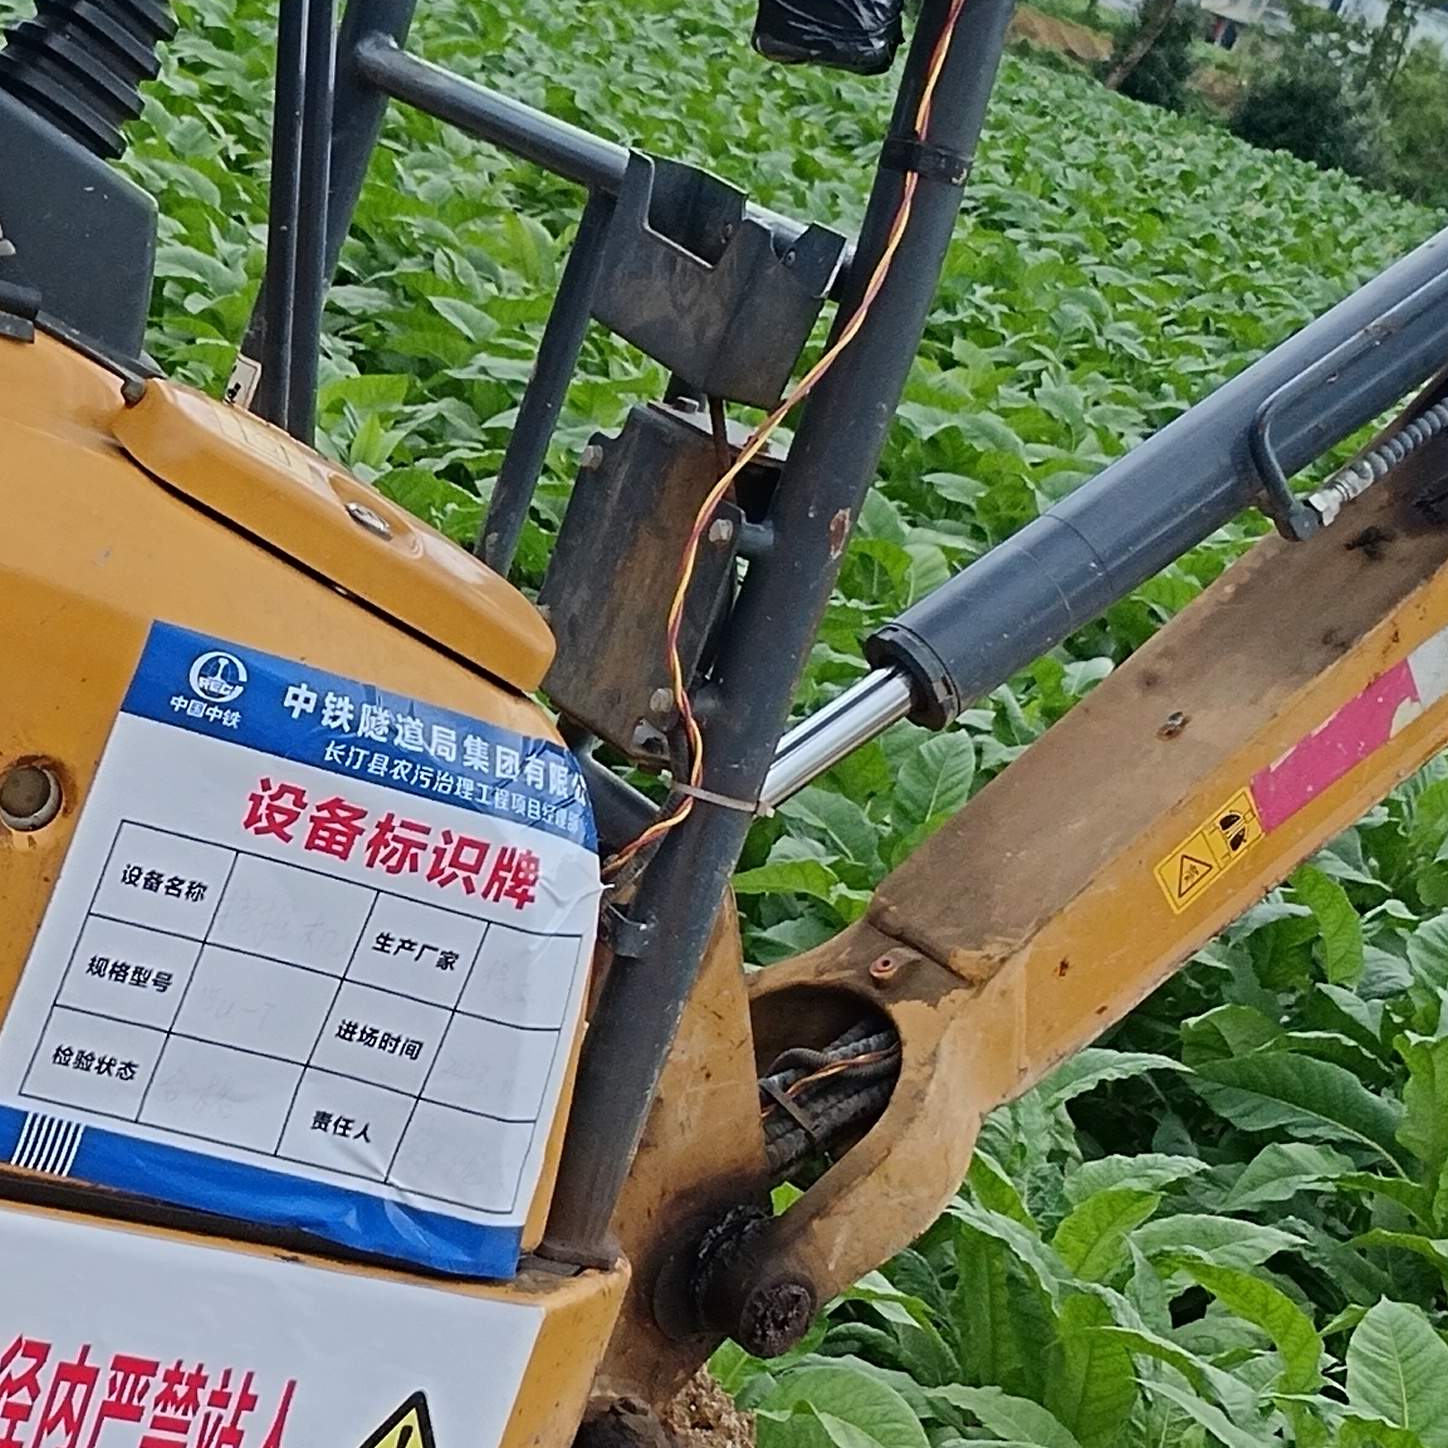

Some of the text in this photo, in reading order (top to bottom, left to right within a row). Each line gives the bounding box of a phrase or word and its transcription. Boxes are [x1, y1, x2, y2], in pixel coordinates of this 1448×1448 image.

[169, 694, 242, 729] 中国中铁
[242, 777, 542, 910] 设备标识牌
[120, 863, 208, 902] 设备名称
[371, 931, 460, 971] 生产厂家
[85, 955, 173, 993] 规格型号
[335, 1019, 424, 1061] 进场时间
[52, 1044, 139, 1082] 检验状态
[310, 1111, 372, 1144] 责任人
